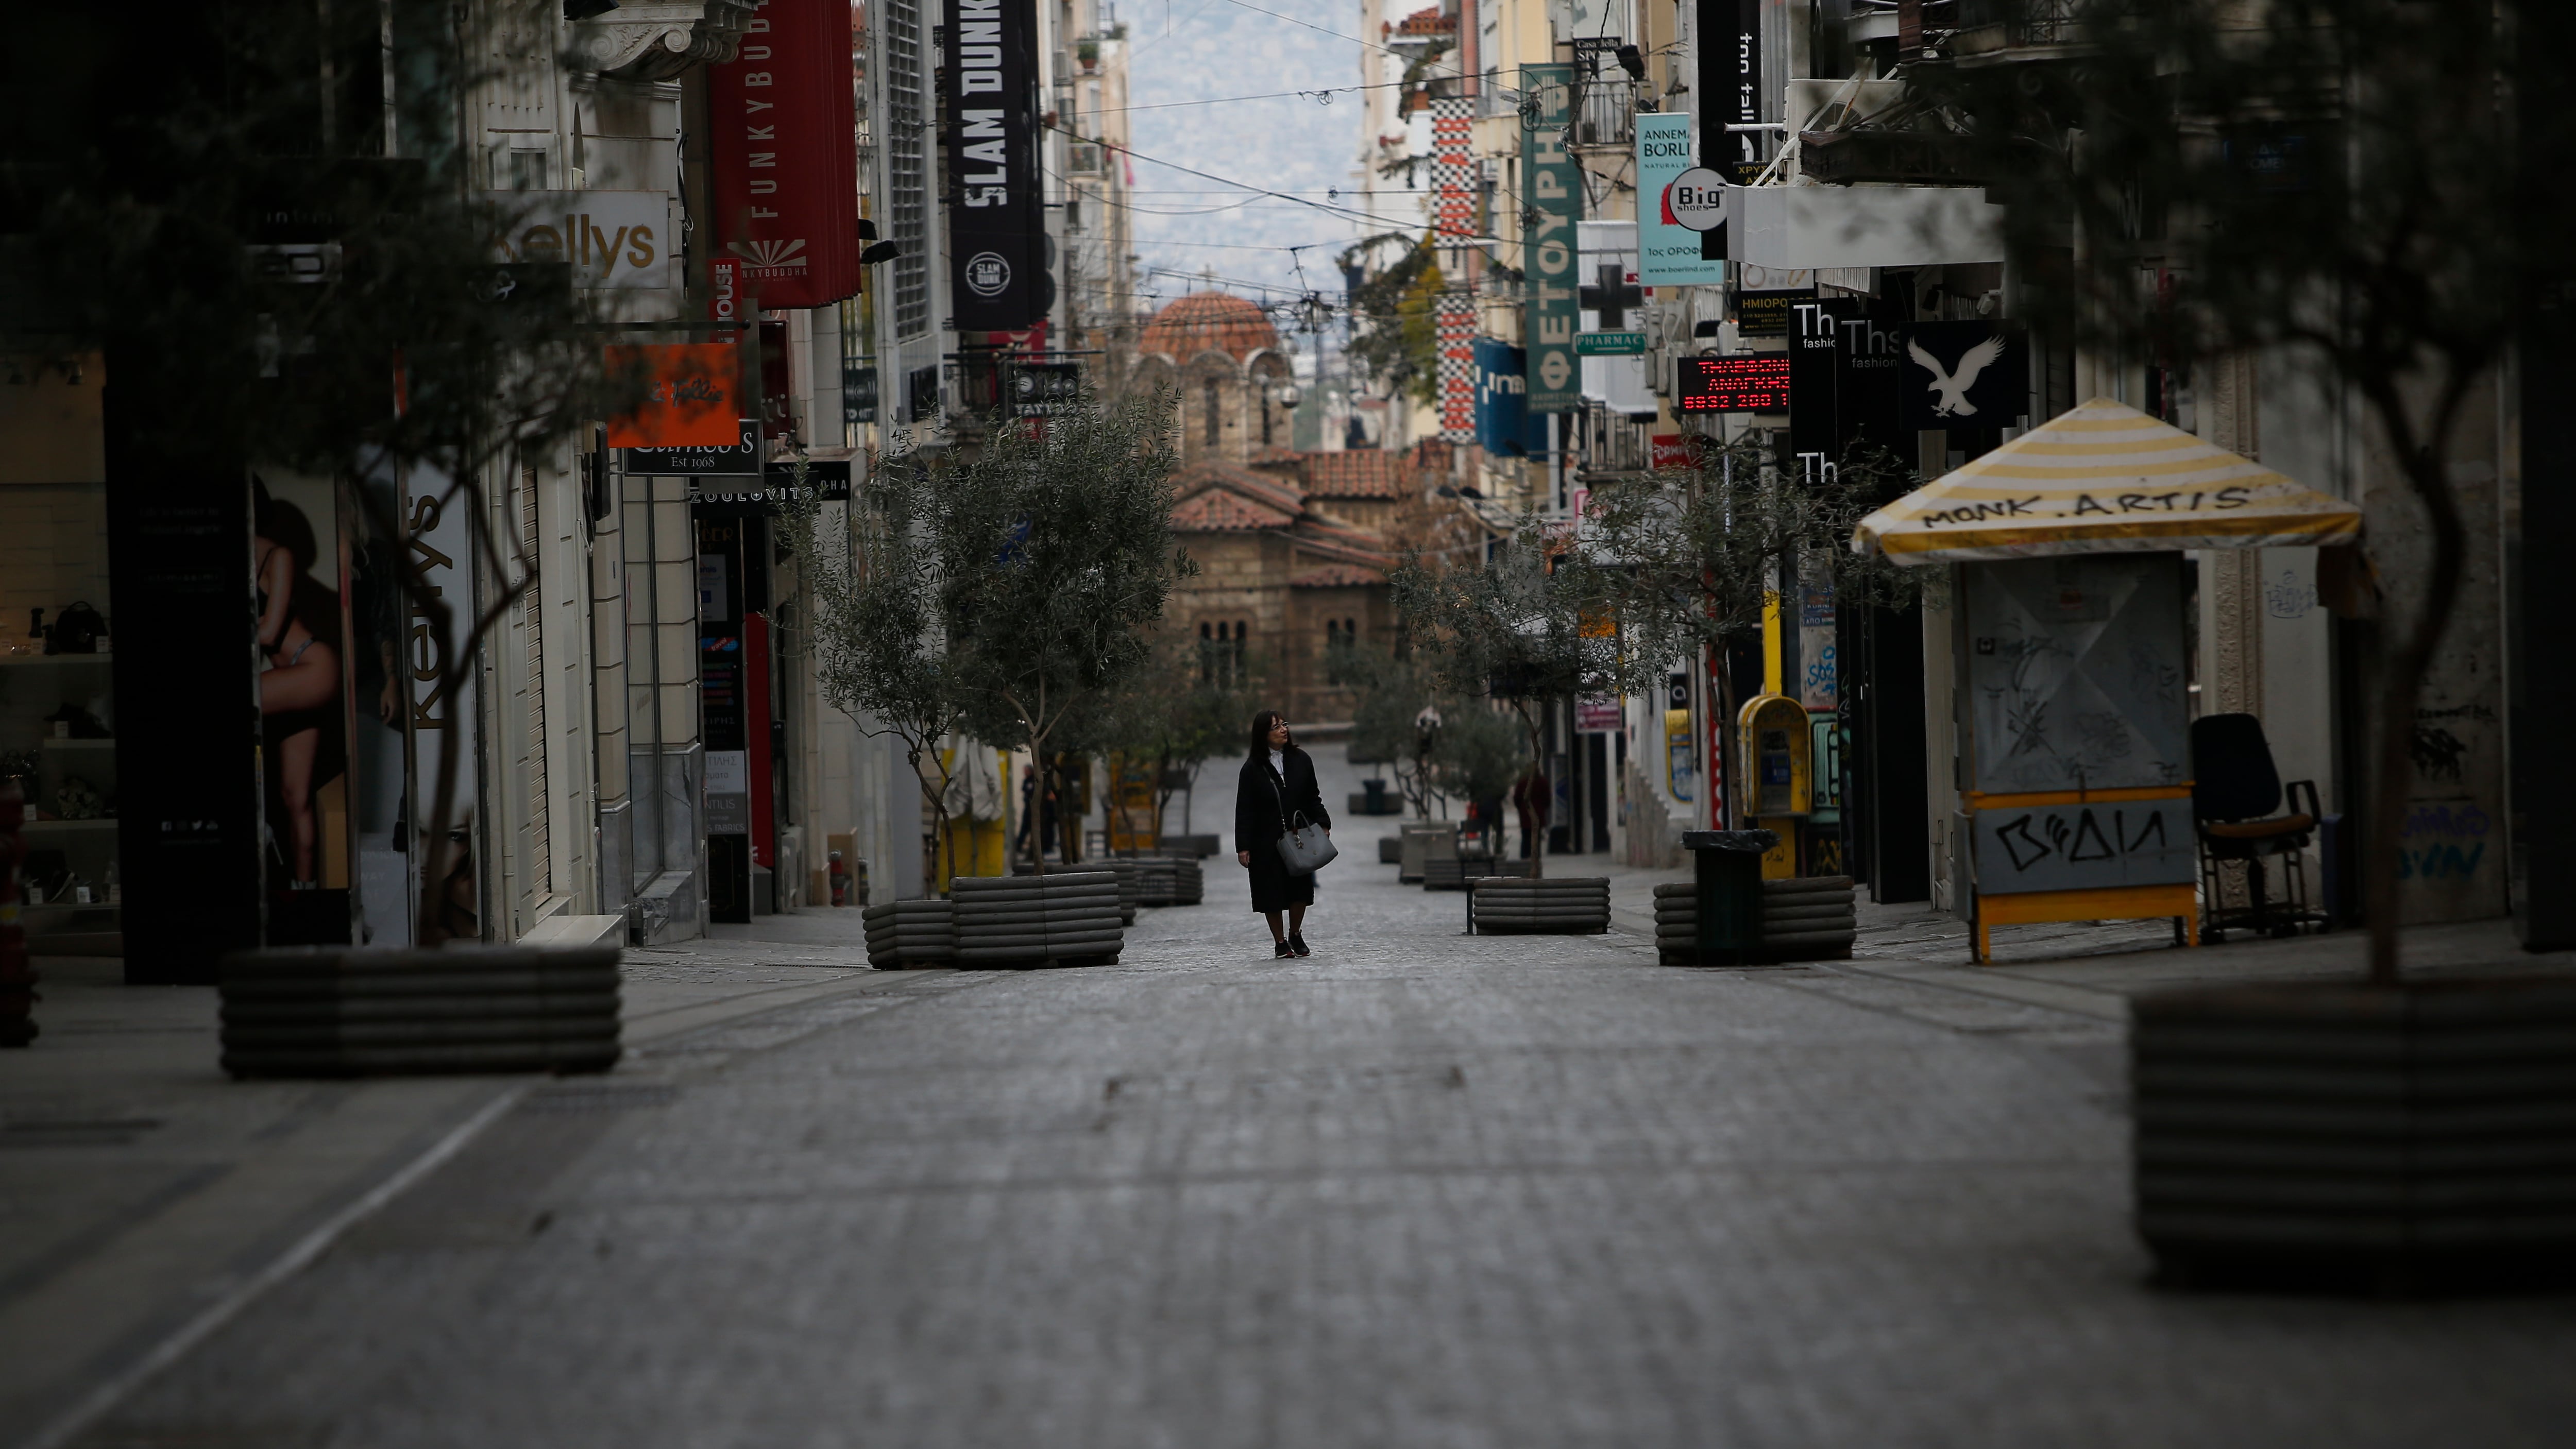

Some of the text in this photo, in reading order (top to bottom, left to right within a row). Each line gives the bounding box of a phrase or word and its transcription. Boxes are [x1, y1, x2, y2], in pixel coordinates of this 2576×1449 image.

[743, 0, 779, 218] FUNKYBUD
[960, 109, 1008, 208] SLAM
[1679, 186, 1721, 209] Big
[1677, 203, 1709, 211] shoes
[976, 263, 1001, 273] SLAM
[977, 274, 1001, 284] DUNK
[1852, 357, 1897, 368] fashion
[1737, 393, 1771, 407] 200
[670, 456, 715, 469] Est 1968
[1923, 495, 2042, 528] MONK
[409, 495, 452, 729] keys
[710, 637, 727, 651] travel
[715, 823, 745, 832] FABRICS
